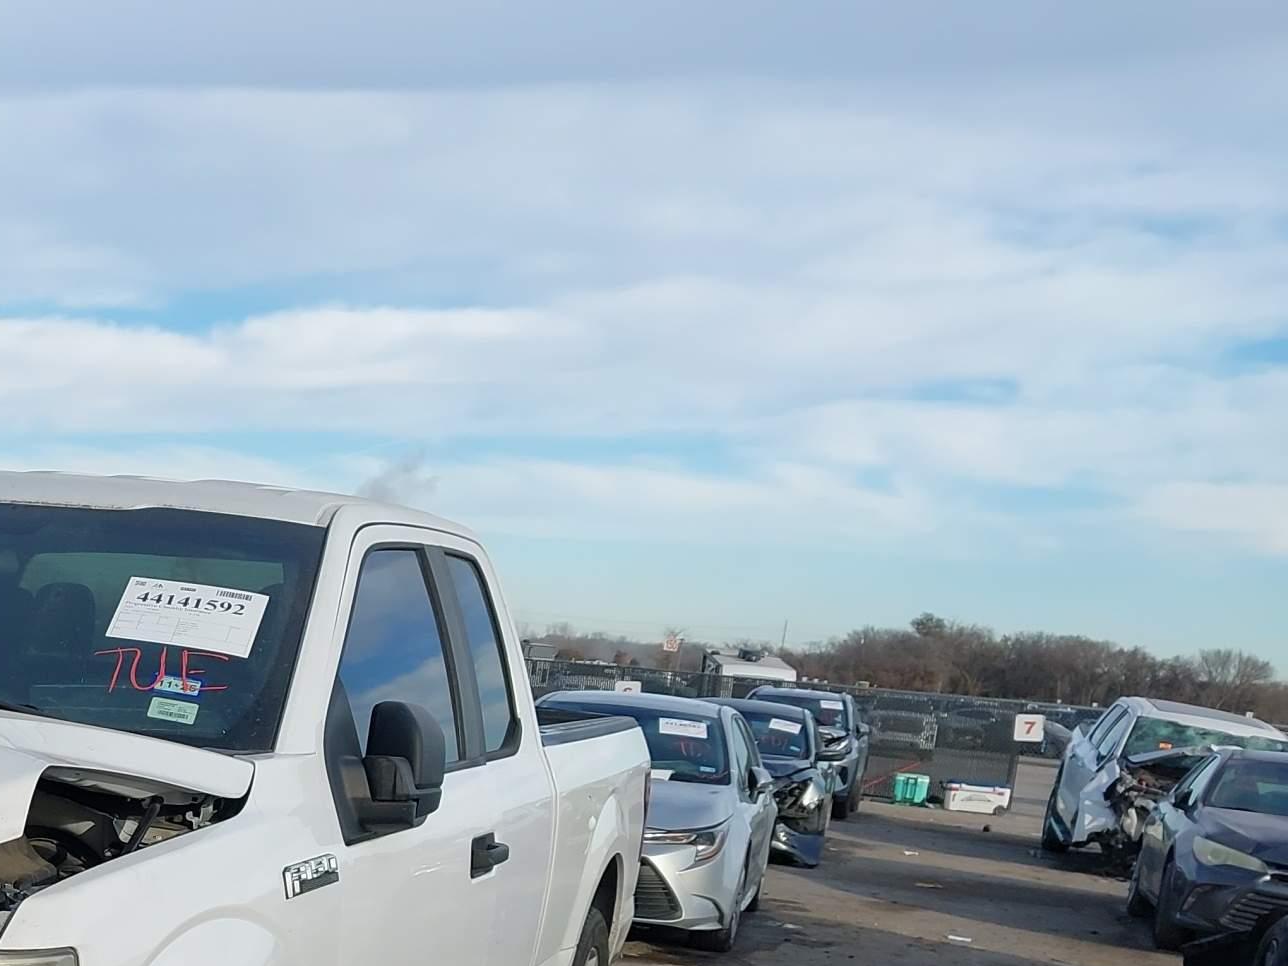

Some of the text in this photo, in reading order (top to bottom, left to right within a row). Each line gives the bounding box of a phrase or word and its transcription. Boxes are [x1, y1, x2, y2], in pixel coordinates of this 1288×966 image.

[136, 592, 246, 615] 44141592
[94, 646, 229, 693] TUE
[1024, 721, 1036, 735] 7
